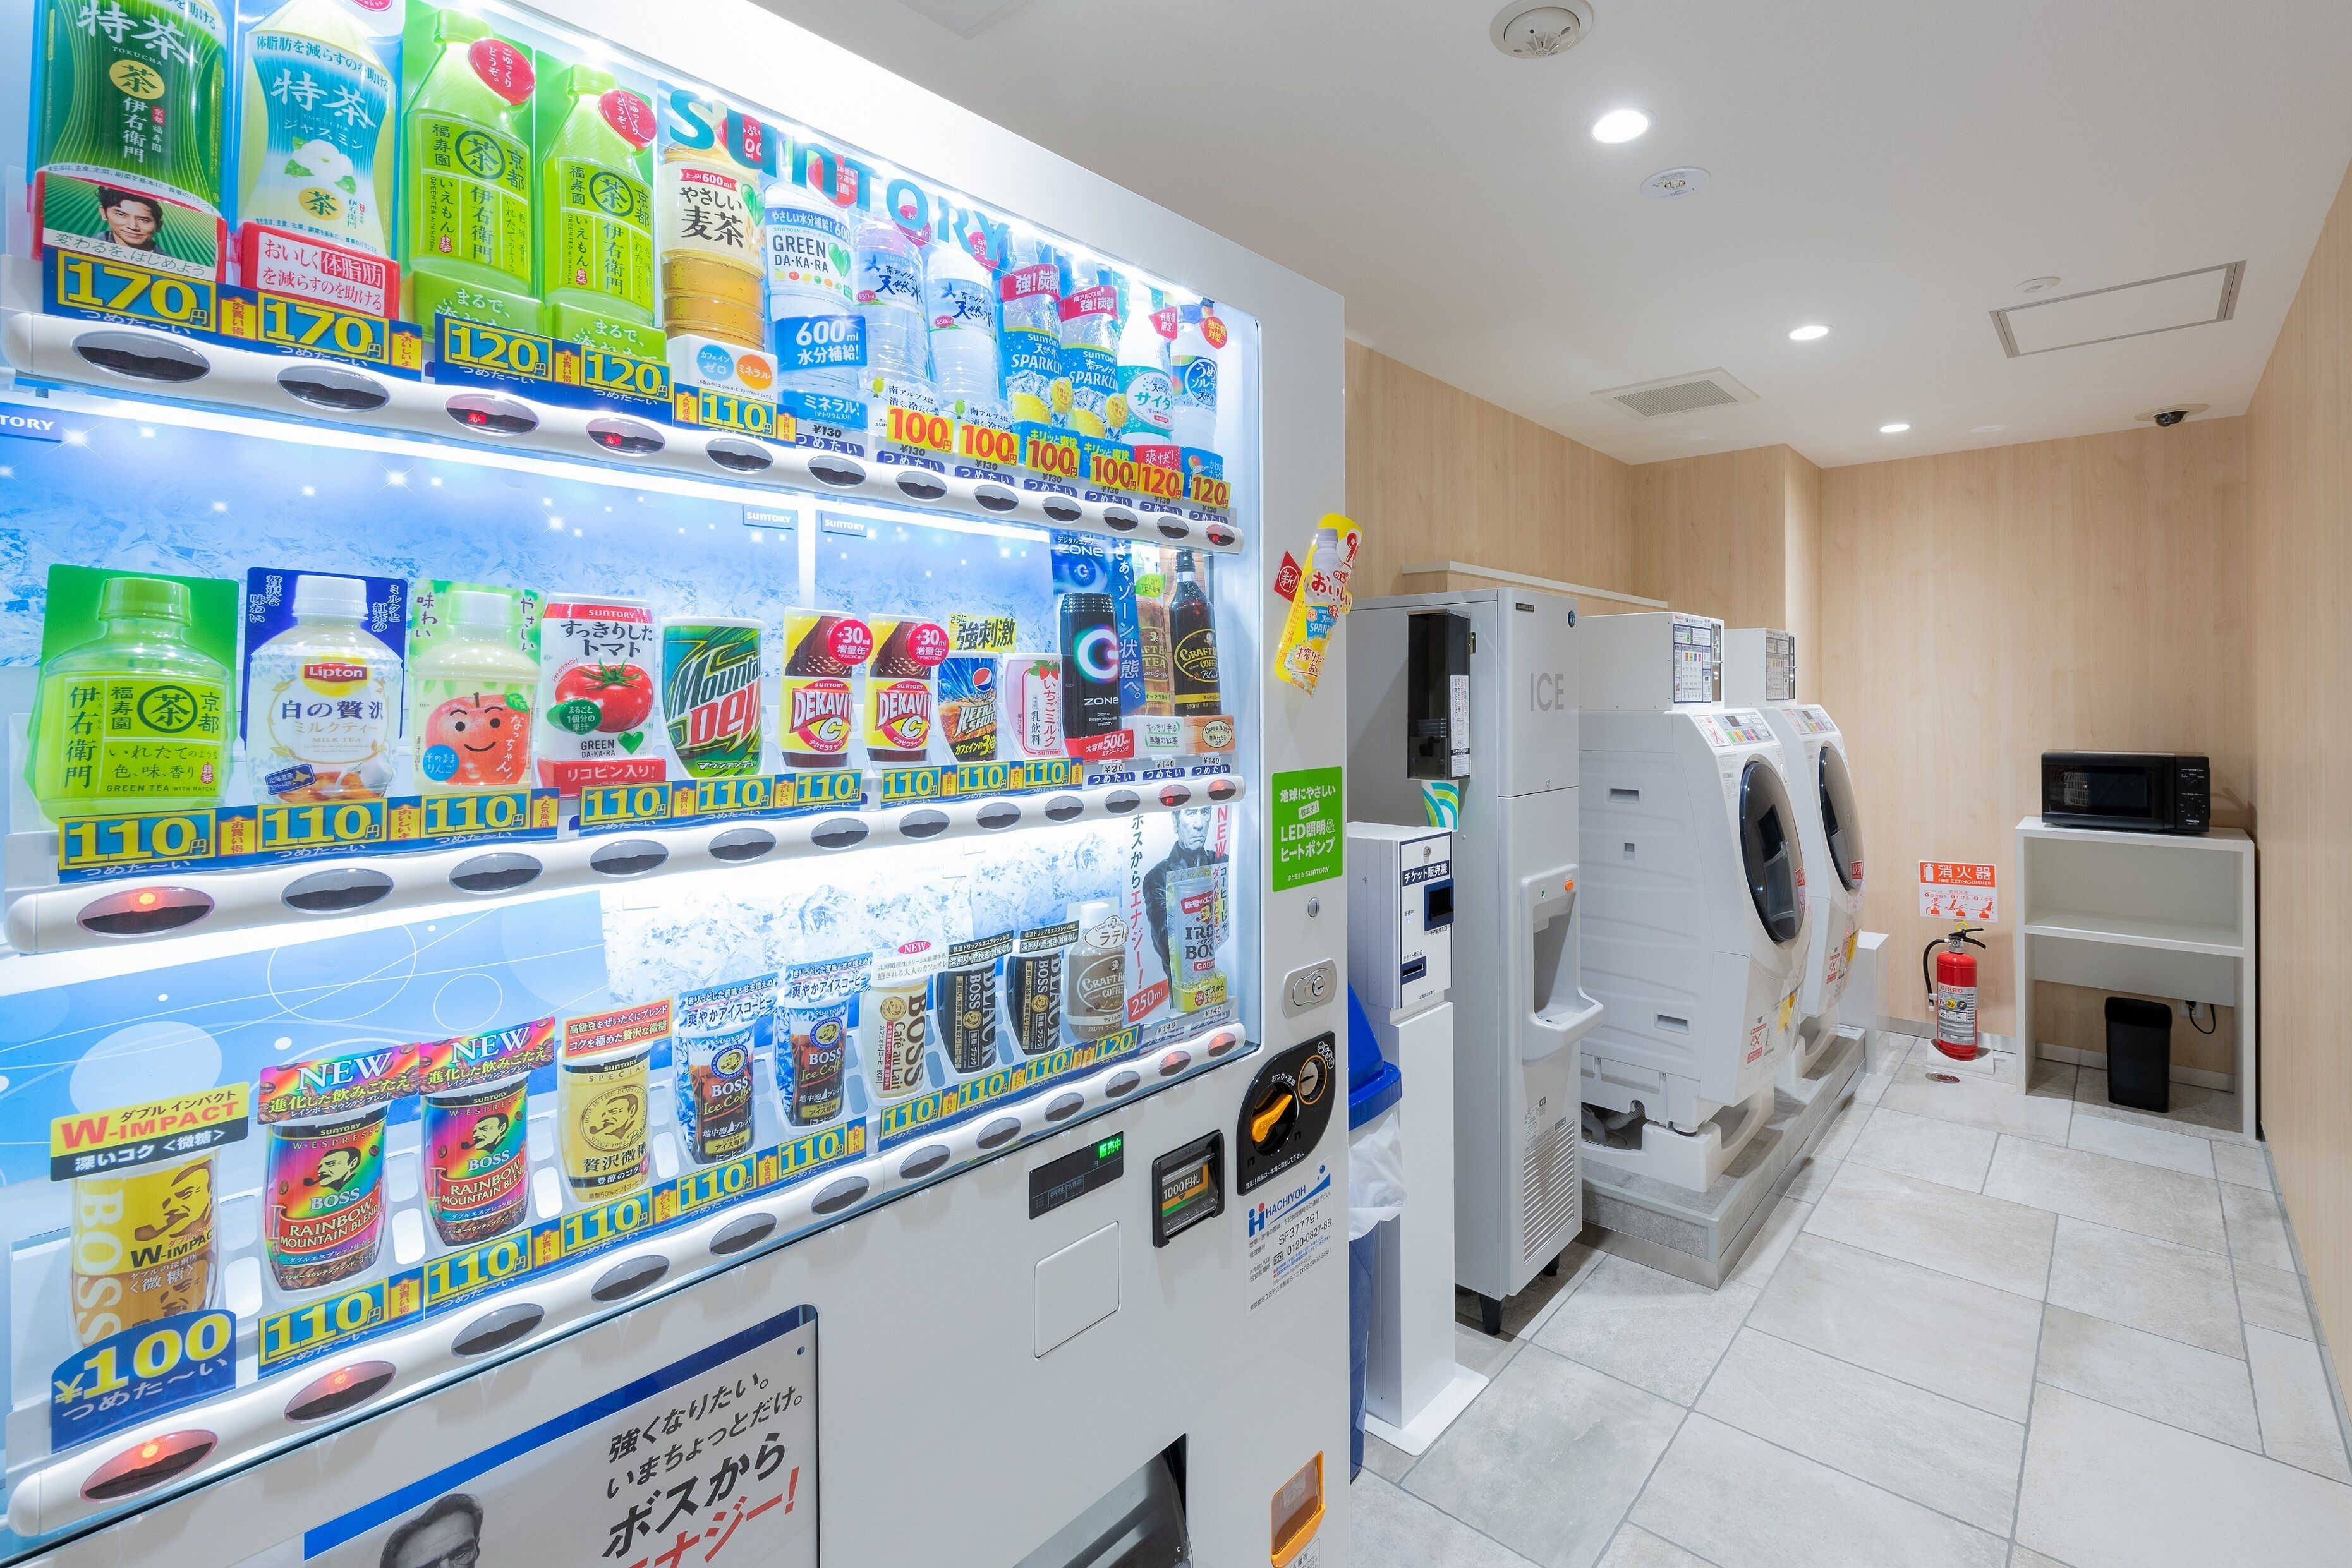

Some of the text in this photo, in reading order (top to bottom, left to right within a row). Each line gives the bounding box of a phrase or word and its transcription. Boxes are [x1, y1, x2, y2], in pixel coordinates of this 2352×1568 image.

[76, 1, 198, 64] 特茶
[112, 46, 162, 66] TOKUCHA
[257, 35, 389, 93] 体脂肪を減らすのを助ける
[270, 68, 377, 129] 特茶
[122, 97, 149, 163] 伊右衛門
[284, 119, 363, 150] ジャスミン
[303, 114, 349, 131] TOKUCHA
[432, 123, 451, 168] 福寿園
[506, 148, 526, 192] 京都
[570, 166, 586, 205] 福寿園
[679, 186, 743, 212] やさしい
[440, 179, 455, 234] いえもん
[634, 189, 650, 229] 京都
[470, 186, 494, 266] 伊右衛門
[681, 205, 744, 248] 麦茶
[53, 233, 205, 276] 変わるを、はじめよう
[576, 216, 589, 267] いえもん
[772, 234, 827, 259] GREEN
[603, 222, 625, 294] 伊右衛門
[67, 260, 208, 325] 170円
[263, 267, 382, 311] を減らすのを助ける
[231, 302, 245, 337] お買い得
[265, 298, 382, 358] 170円
[795, 320, 859, 346] 600ml
[451, 326, 547, 376] 120円
[700, 349, 730, 363] カフェイン
[797, 345, 860, 366] 水分補給!
[586, 351, 669, 399] 120円
[703, 362, 727, 376] ゼロ
[738, 363, 772, 380] ミネラル
[682, 395, 690, 422] 人気商品
[703, 393, 773, 435] 110円
[803, 394, 861, 417] ミネラル!
[797, 433, 859, 455] つめたい
[812, 424, 842, 438] ¥130
[884, 454, 939, 473] つめたい
[900, 444, 926, 457] ¥130
[974, 459, 998, 471] ¥130
[265, 574, 283, 606] 贅沢な
[1311, 571, 1352, 606] おいしい
[249, 594, 265, 623] 味わい
[372, 602, 387, 632] 紅茶の
[387, 584, 402, 623] ミルクと
[415, 591, 438, 638] 味わい
[519, 597, 535, 651] やさしい
[560, 620, 653, 642] すっきりした
[837, 627, 871, 646] +30ml
[916, 629, 947, 648] +30ml
[957, 618, 1016, 651] 強刺激
[583, 639, 641, 658] トマト
[309, 665, 363, 680] Lipton
[1530, 672, 1565, 712] ICE
[111, 686, 134, 730] 福寿園
[197, 691, 221, 734] 京都
[282, 699, 384, 721] 白の贅沢
[568, 706, 593, 715] まるごと
[1043, 680, 1057, 748] いちごミルク
[64, 685, 101, 790] 伊右衛門
[294, 721, 379, 734] ミルクティー
[572, 723, 590, 732] 果汁
[1031, 710, 1041, 745] 乳飲料
[109, 745, 219, 760] いれたてのような
[424, 752, 456, 764] そのまま
[580, 739, 615, 751] GREEN
[427, 764, 455, 775] りんご
[567, 764, 656, 782] リコピン入り!
[1156, 760, 1175, 769] ¥140
[1280, 785, 1336, 804] 地球にやさしい
[1300, 803, 1318, 817] 省エネ!
[68, 816, 207, 865] 110円
[1215, 805, 1228, 859] NEW
[1280, 818, 1335, 843] LED照明&
[1280, 837, 1336, 862] ヒートポンプ
[1287, 866, 1330, 882] 水と生きる SUNTORY
[1404, 864, 1448, 884] チケット販売機
[1937, 864, 1992, 881] 消火器
[903, 942, 927, 955] NEW
[1100, 929, 1125, 947] ラテ!
[1403, 950, 1423, 960] チケット発行口
[877, 961, 947, 981] 癒される大人のカフェオレ
[791, 975, 868, 999] 爽やかアイスコーヒー
[688, 997, 773, 1027] 爽やかアイスコーヒー
[1131, 990, 1163, 1016] 250ml
[569, 1003, 668, 1035] 高級豆をぜいたくにブレンド
[449, 1025, 531, 1064] NEW
[568, 1020, 667, 1052] コクを極めた贅沢な微糖
[427, 1047, 548, 1085] 進化した飲みごたえ
[808, 1047, 842, 1066] BOSS
[296, 1052, 394, 1092] NEW
[446, 1062, 533, 1088] レインボーマウンテンブレンド
[588, 1064, 646, 1083] SPECIAL
[268, 1075, 412, 1114] 進化した飲みごたえ
[710, 1076, 749, 1098] BOSS
[291, 1092, 392, 1118] レインボーマウンテンブレンド
[809, 1103, 837, 1117] アイス専用
[61, 1101, 239, 1149] W-IMPACT
[714, 1135, 746, 1152] アイス専用
[1099, 1138, 1122, 1159] 販売中
[468, 1149, 510, 1172] BOSS
[442, 1164, 525, 1207] MOUNTAIN BLEND
[450, 1158, 521, 1197] RAINBOW
[597, 1168, 640, 1185] 豊醇のコク
[1163, 1174, 1201, 1200] 1000円札
[310, 1188, 360, 1211] BOSS
[1265, 1185, 1307, 1219] HACHIYOH
[280, 1203, 378, 1248] MOUNTAIN BLEND
[289, 1198, 373, 1237] RAINBOW
[1278, 1210, 1320, 1246] SF377791
[1287, 1218, 1332, 1256] 0120-0827-88
[55, 1313, 232, 1404] ¥100
[608, 1373, 770, 1464] 強くなりたい。
[607, 1385, 803, 1500] いまちょっとだけ。
[601, 1432, 785, 1560] ボスから
